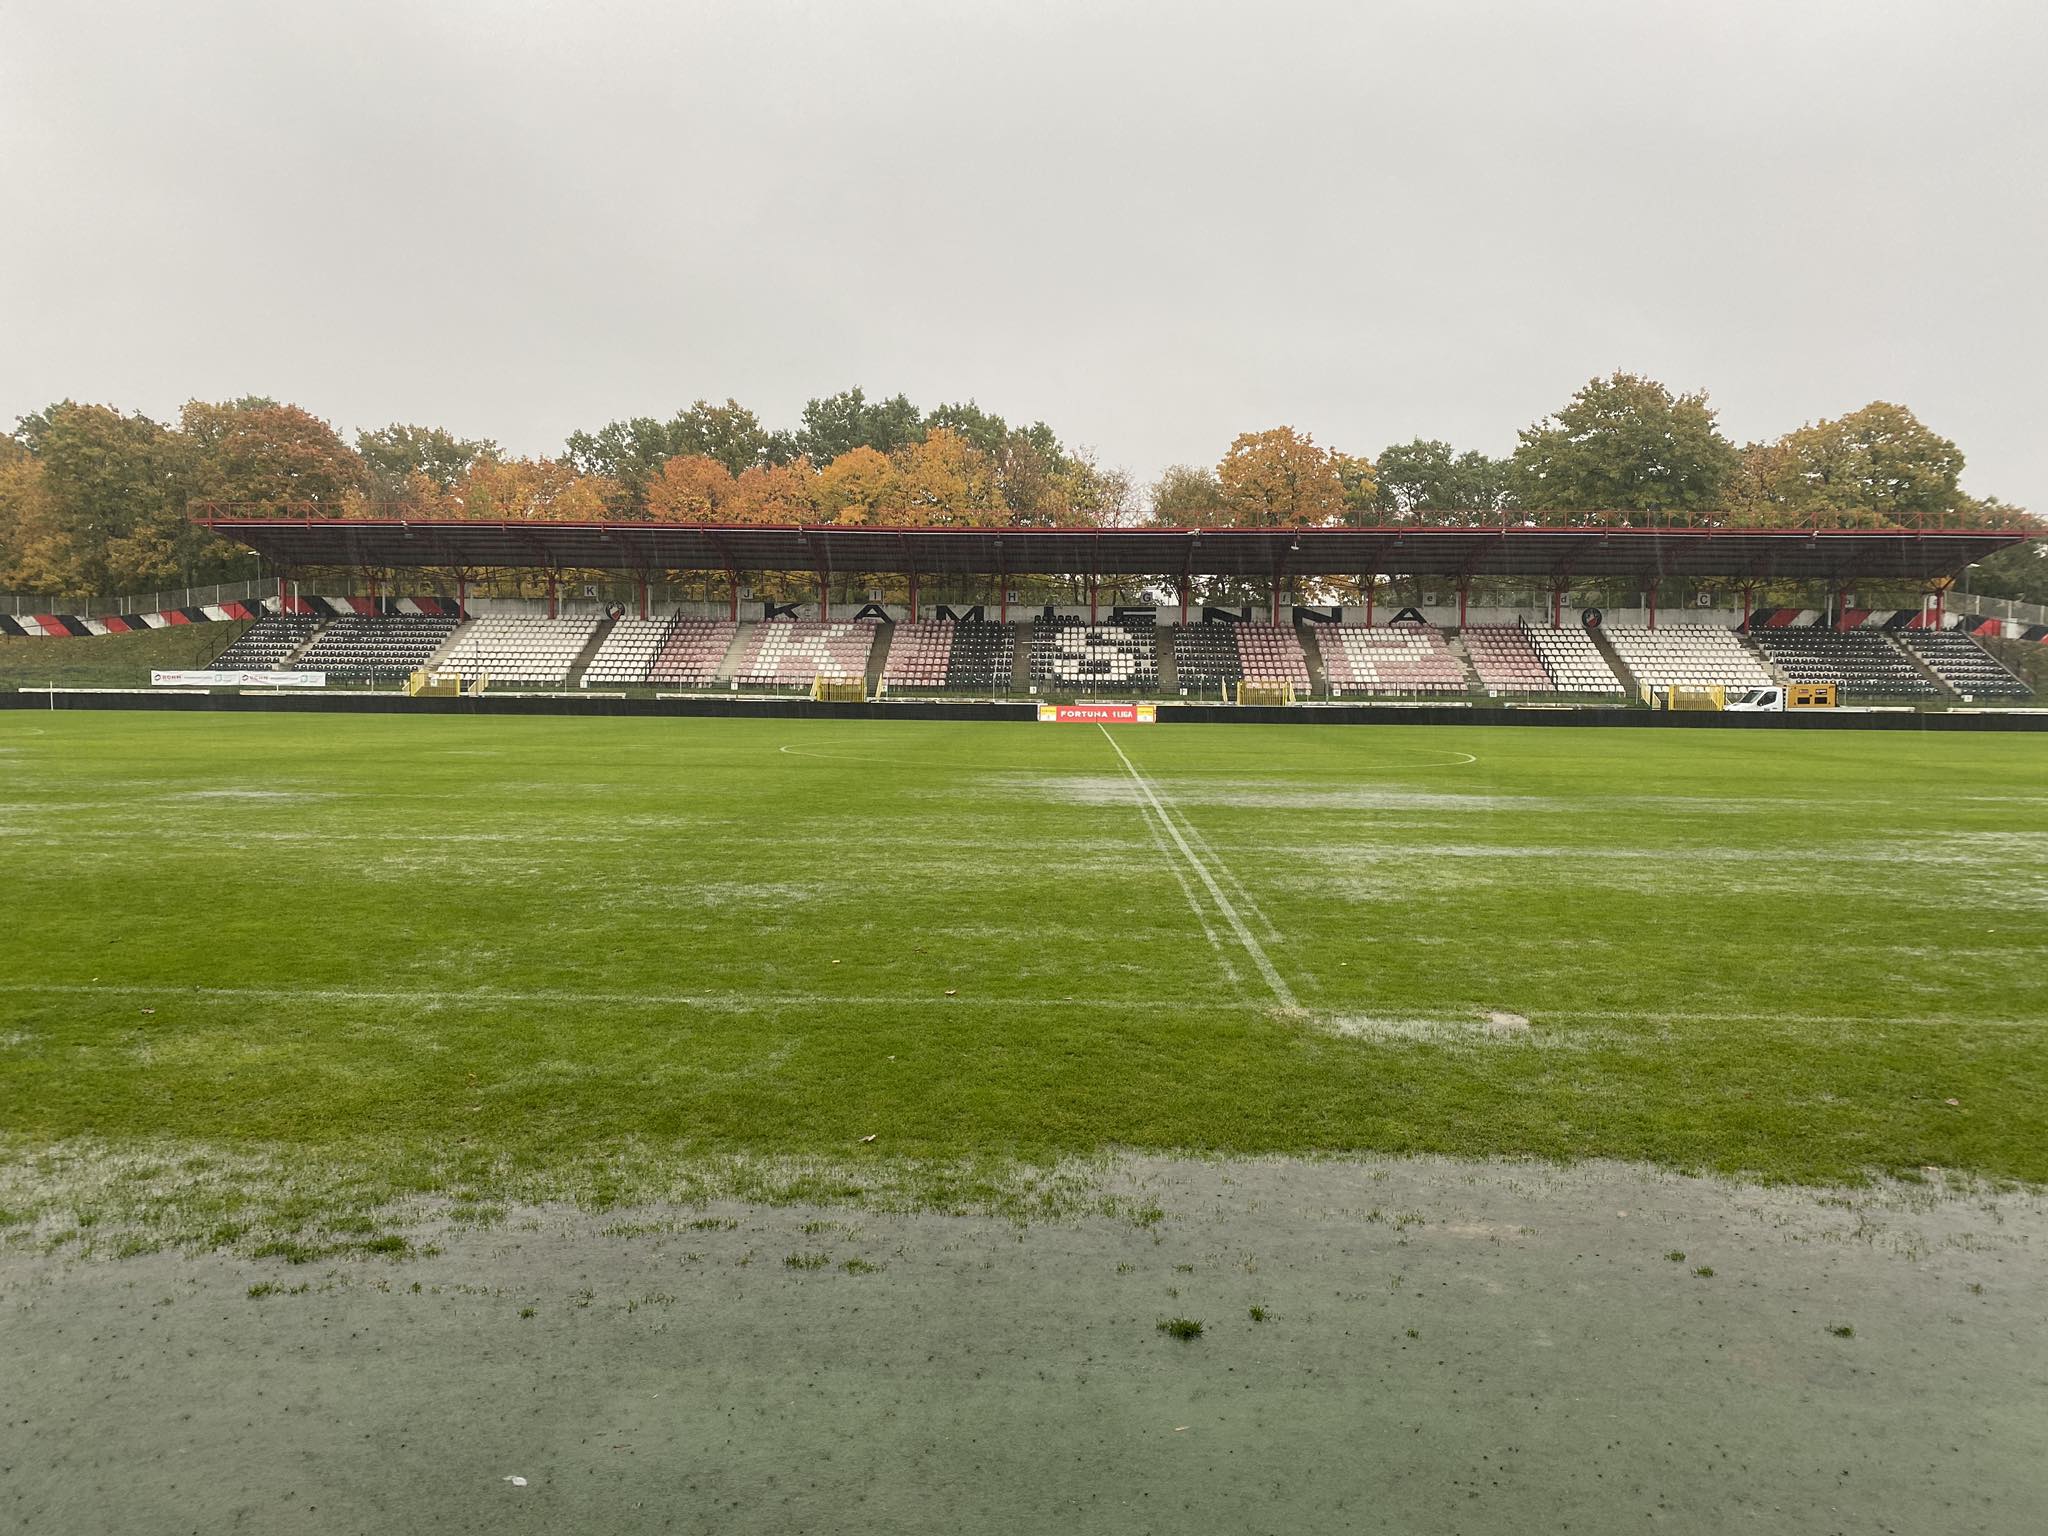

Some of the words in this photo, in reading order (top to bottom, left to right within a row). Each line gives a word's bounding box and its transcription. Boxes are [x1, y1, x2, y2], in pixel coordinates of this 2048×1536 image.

[586, 586, 594, 595] K
[1008, 592, 1017, 602] H
[1700, 595, 1708, 605] C
